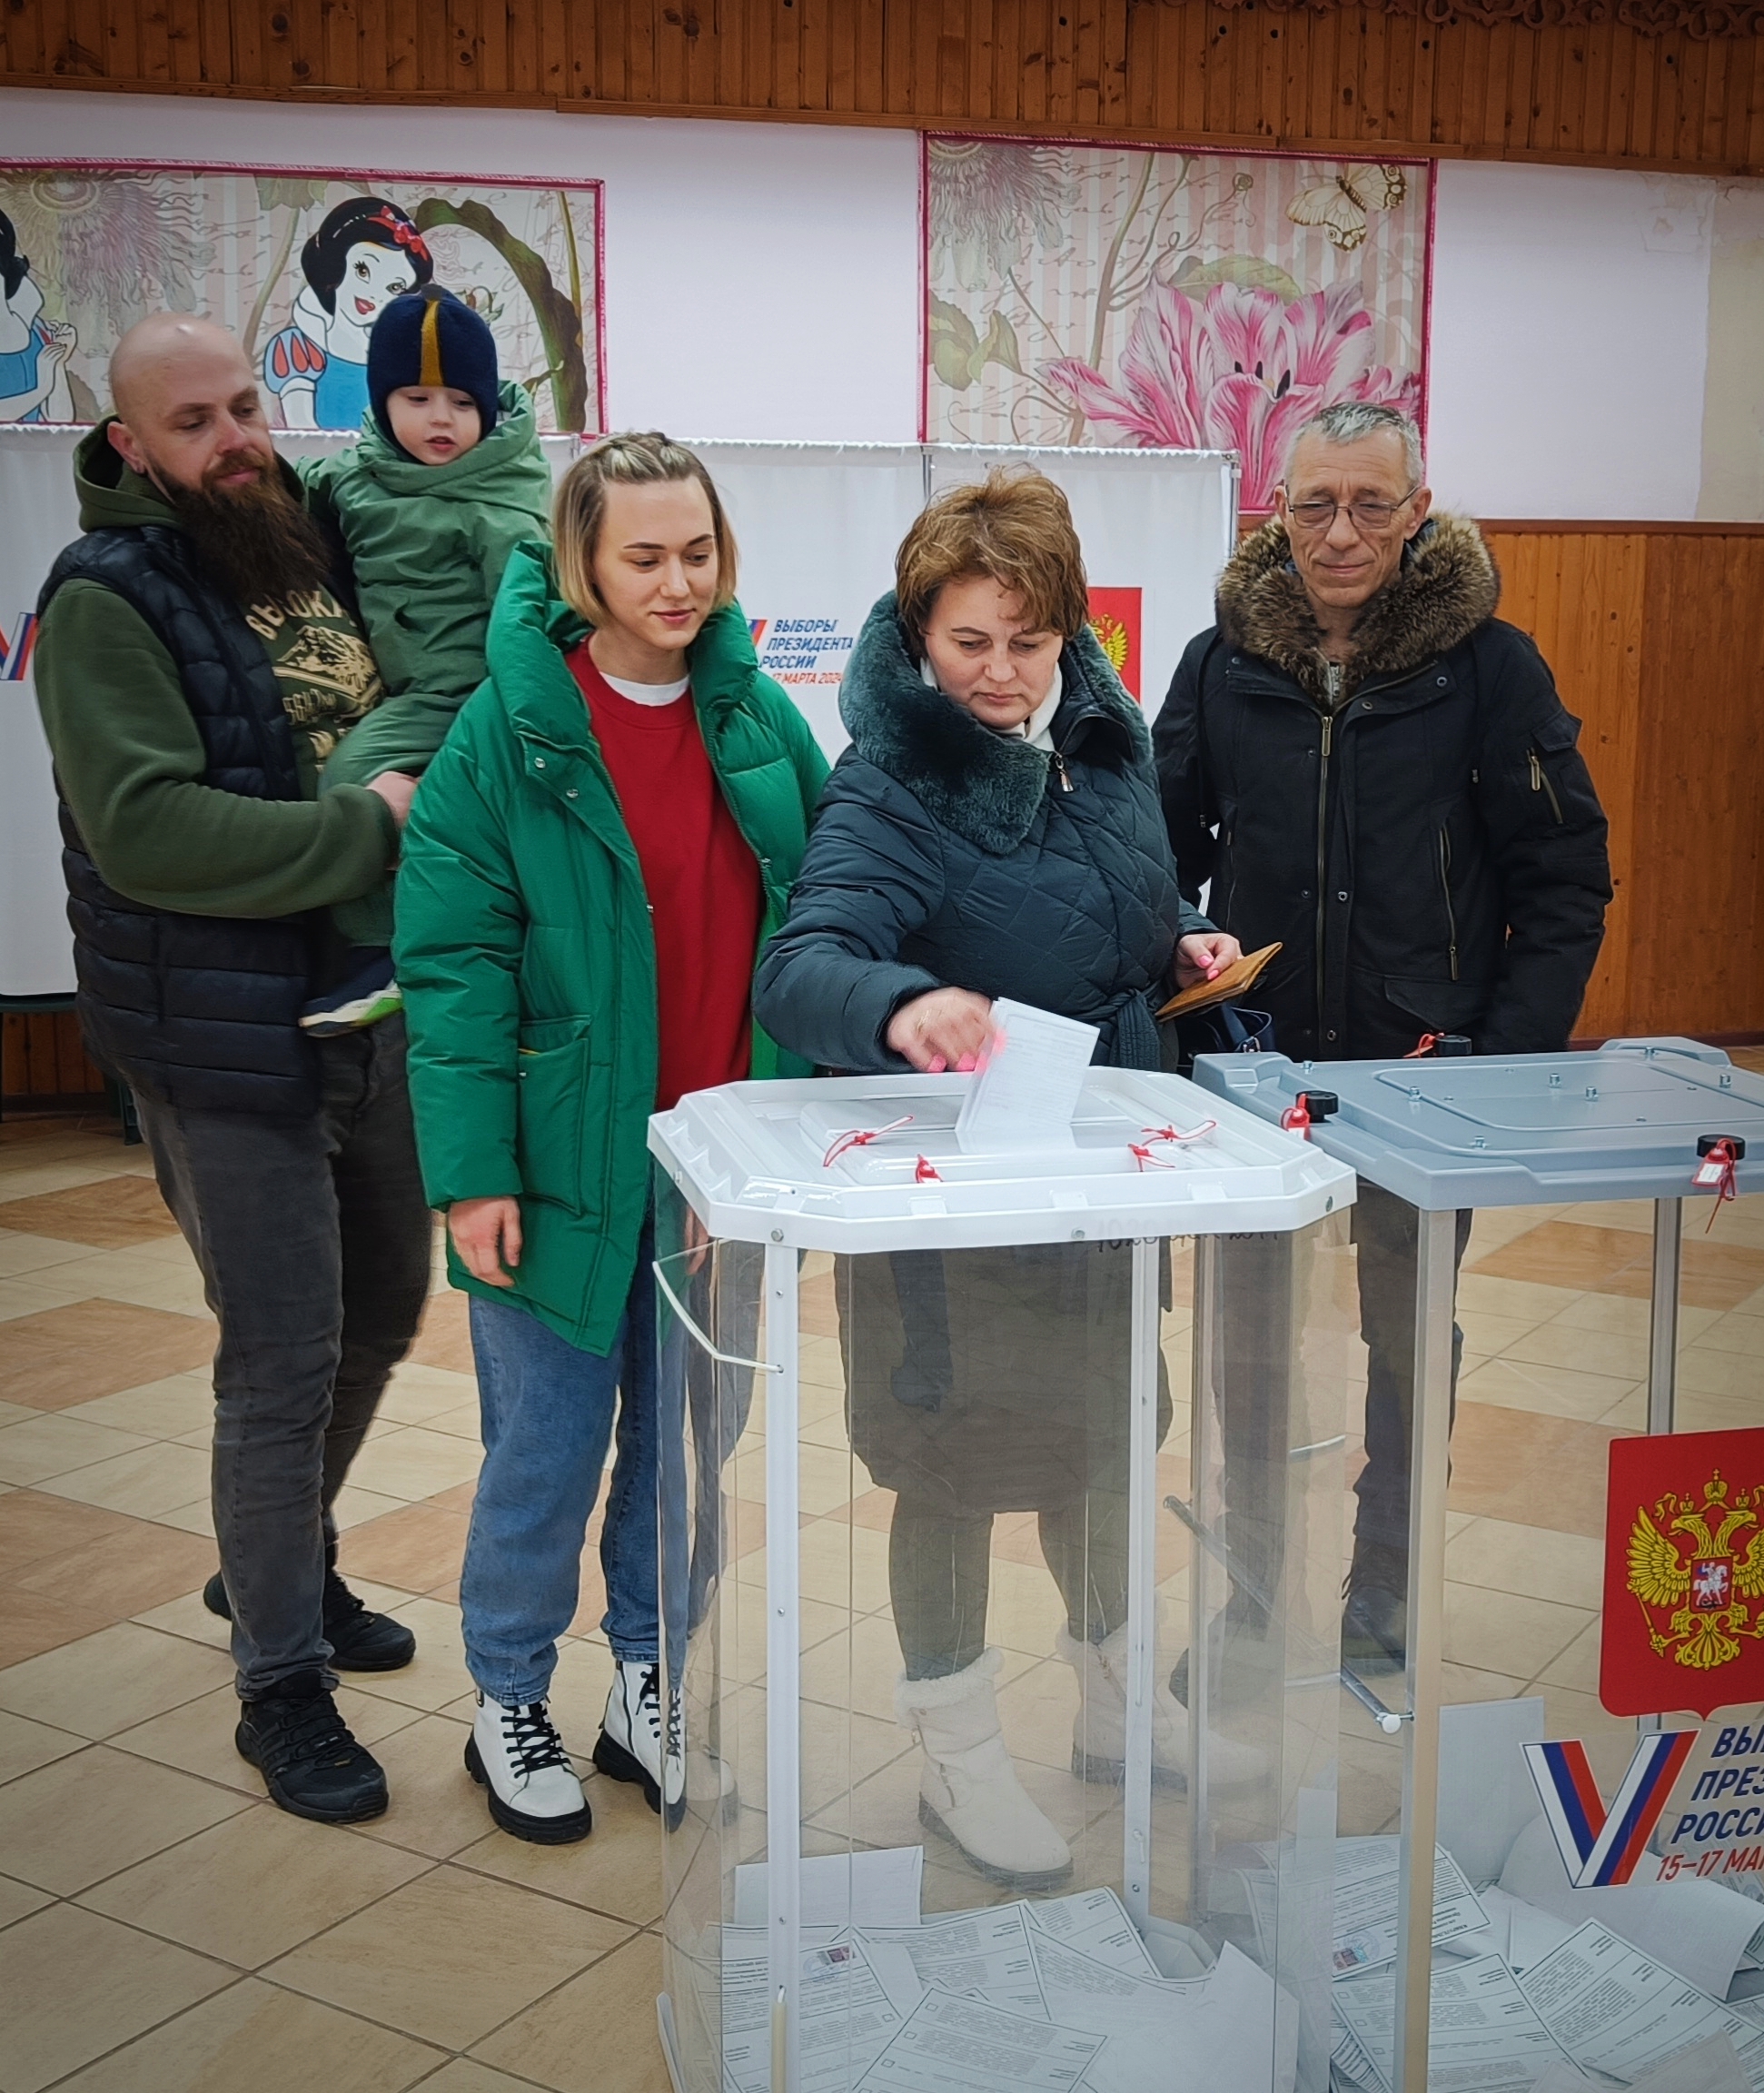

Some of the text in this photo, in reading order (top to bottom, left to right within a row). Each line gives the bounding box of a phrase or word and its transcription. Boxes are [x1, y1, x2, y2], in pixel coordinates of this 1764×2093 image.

[774, 619, 838, 632] ВЫБОРЫ
[766, 637, 854, 652] ПРЕЗИДЕНТА
[759, 655, 818, 669] РОССИИ
[782, 673, 817, 684] МАРТА
[1722, 1845, 1764, 1874] МА
